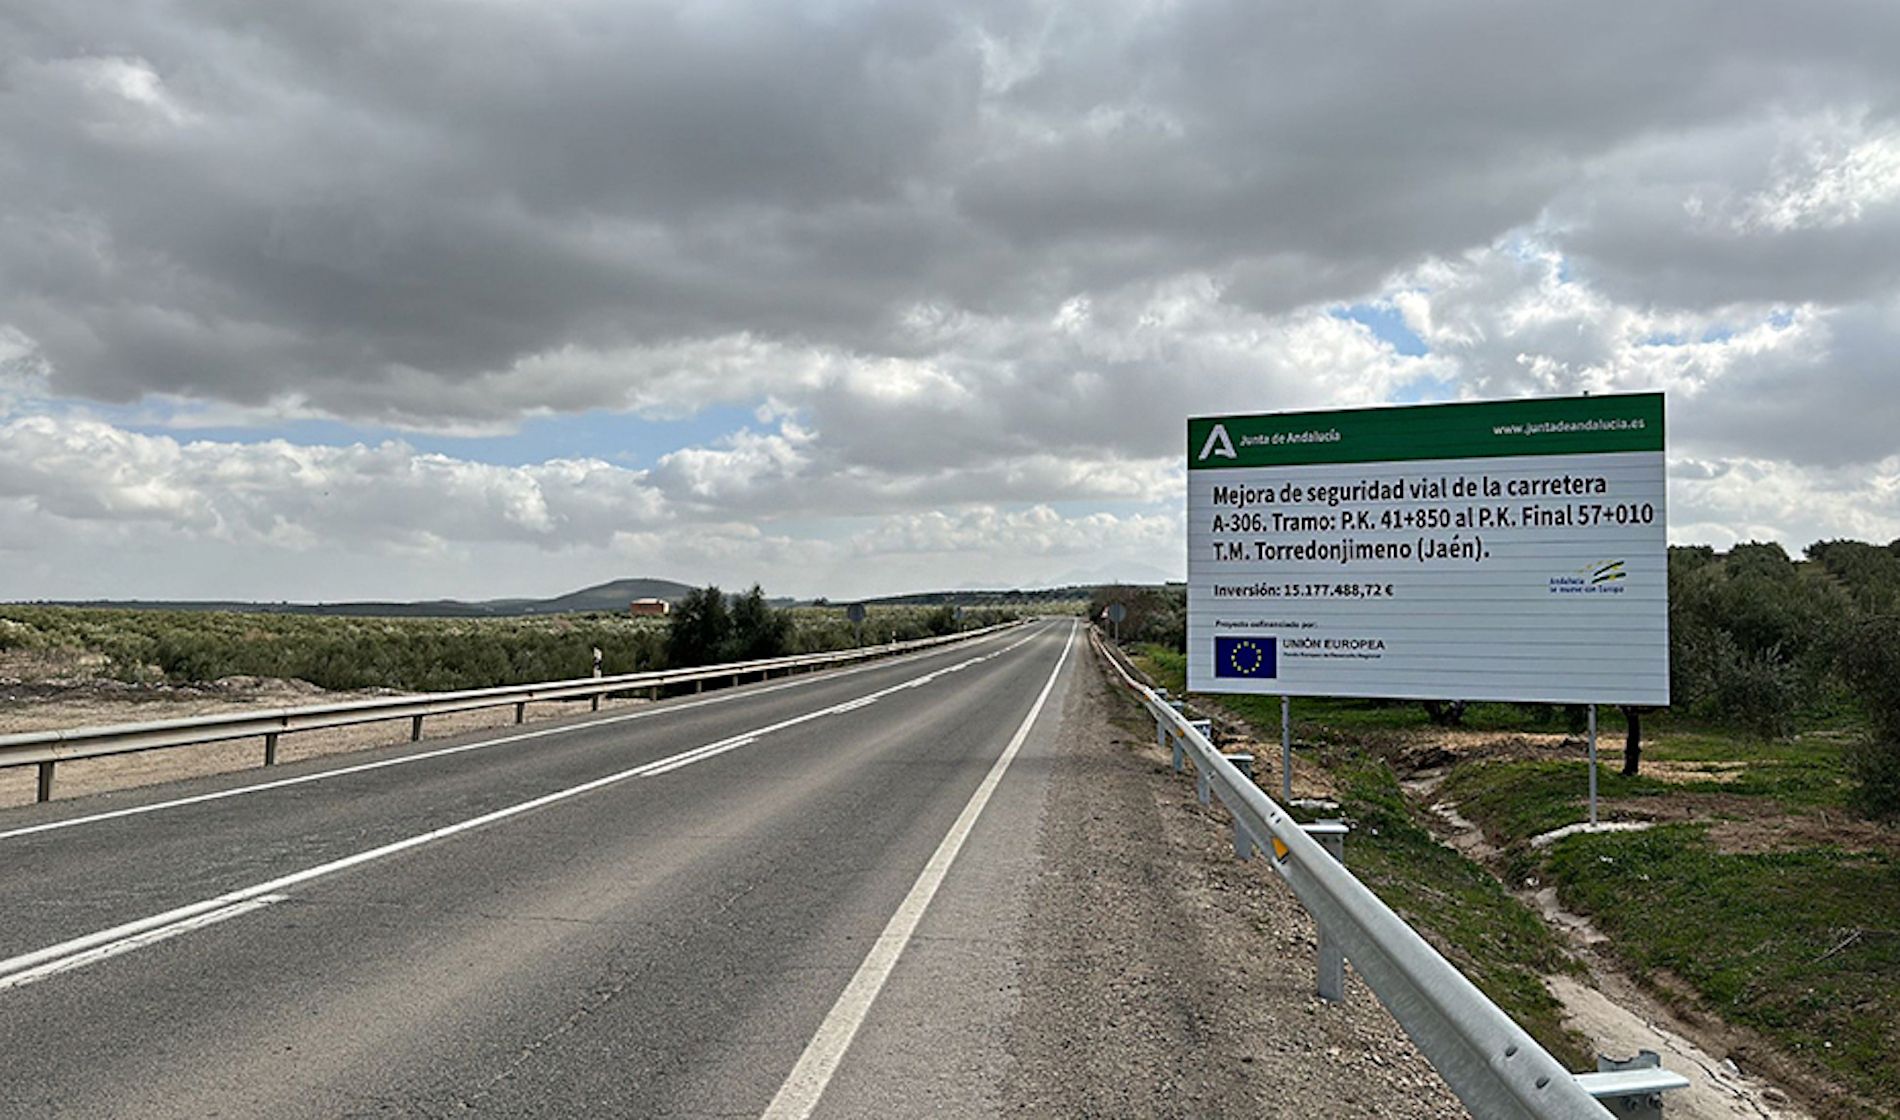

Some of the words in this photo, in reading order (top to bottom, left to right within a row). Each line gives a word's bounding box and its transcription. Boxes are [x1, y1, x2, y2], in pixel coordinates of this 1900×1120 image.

[1493, 418, 1645, 436] www.juntadeandalucia.es
[1239, 434, 1270, 446] Junta
[1271, 433, 1285, 444] de
[1286, 428, 1341, 444] Andalucía
[1213, 484, 1275, 509] Mejora
[1280, 483, 1302, 502] de
[1307, 478, 1404, 506] seguridad
[1410, 476, 1446, 499] vial
[1452, 477, 1477, 497] de
[1483, 476, 1501, 496] la
[1507, 474, 1606, 495] carretera
[1212, 513, 1267, 532] A-306.
[1272, 513, 1336, 531] Tramo:
[1341, 511, 1376, 530] P.K.
[1381, 508, 1450, 529] 41+850
[1455, 507, 1473, 527] al
[1479, 507, 1516, 527] P.K.
[1522, 504, 1573, 526] Final
[1577, 503, 1653, 525] 57+010
[1213, 542, 1250, 560] T.M.
[1254, 539, 1412, 564] Torredonjimeno
[1417, 534, 1490, 562] (Jaén).
[1214, 582, 1281, 597] Inversión:
[1282, 638, 1321, 649] UNIÓN
[1324, 639, 1385, 650] EUROPEA
